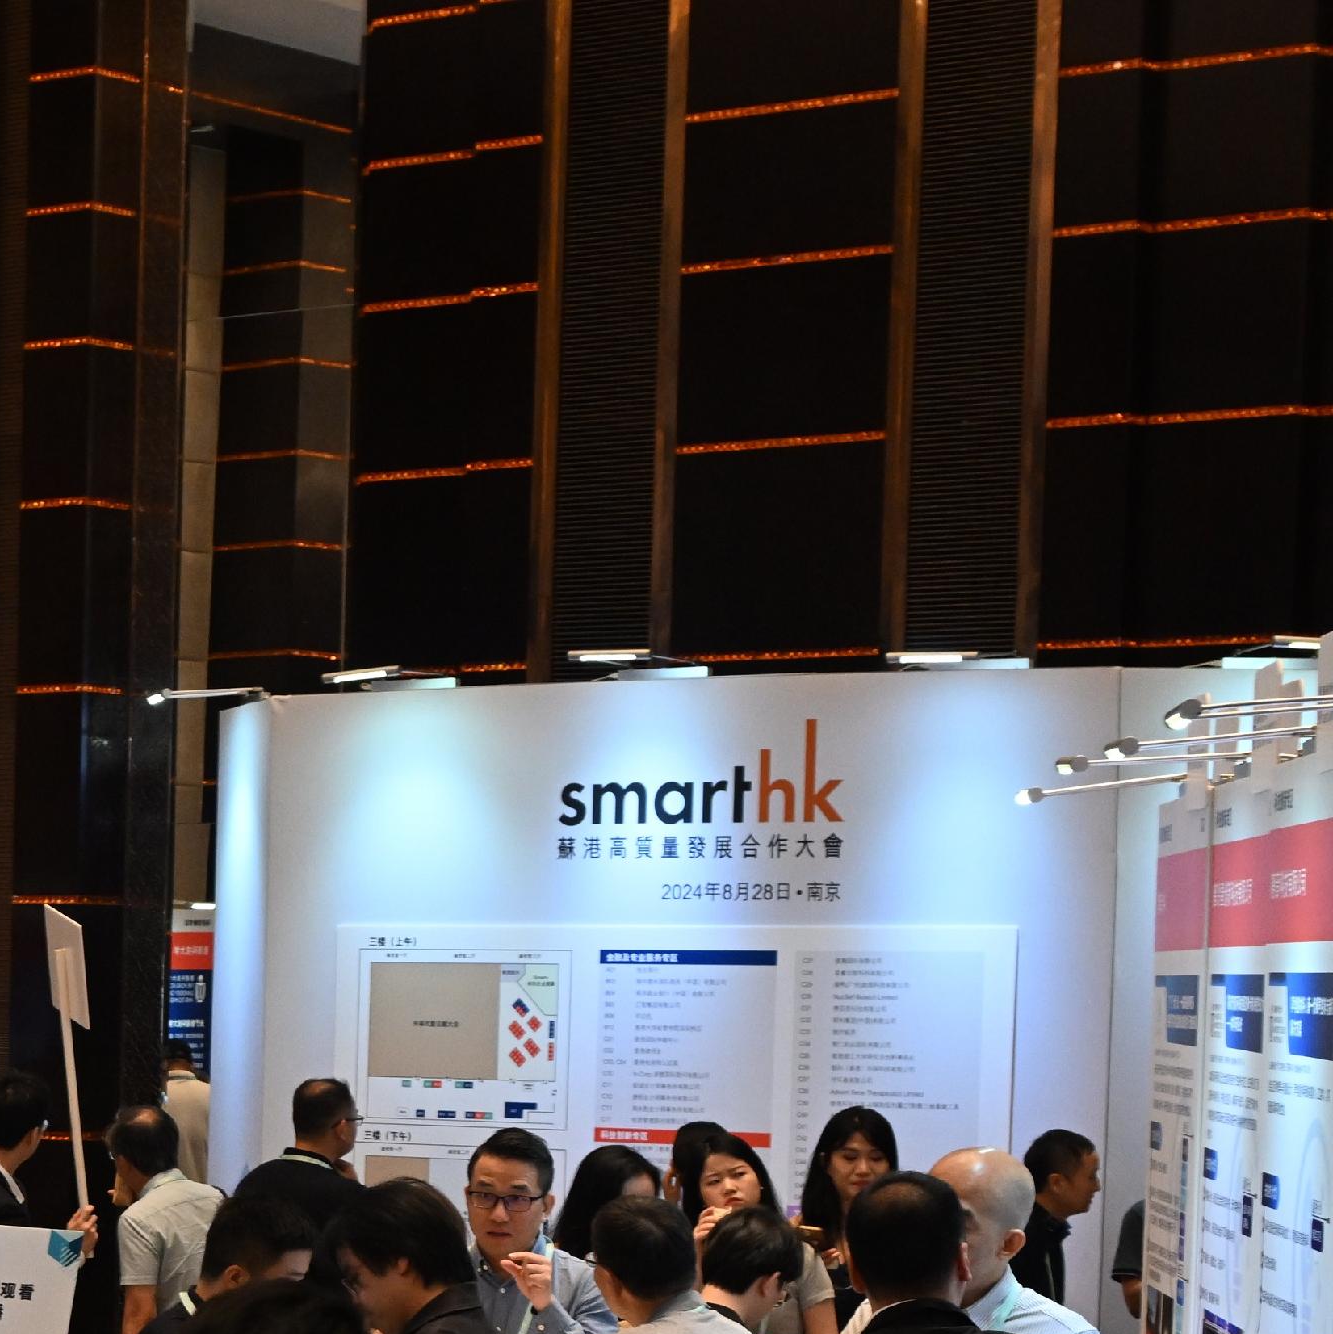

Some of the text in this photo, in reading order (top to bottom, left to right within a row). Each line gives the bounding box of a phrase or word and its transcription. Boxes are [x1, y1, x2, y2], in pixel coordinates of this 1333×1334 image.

[559, 719, 844, 825] smarthk
[557, 832, 844, 861] 蘇港高質量發展合作大會
